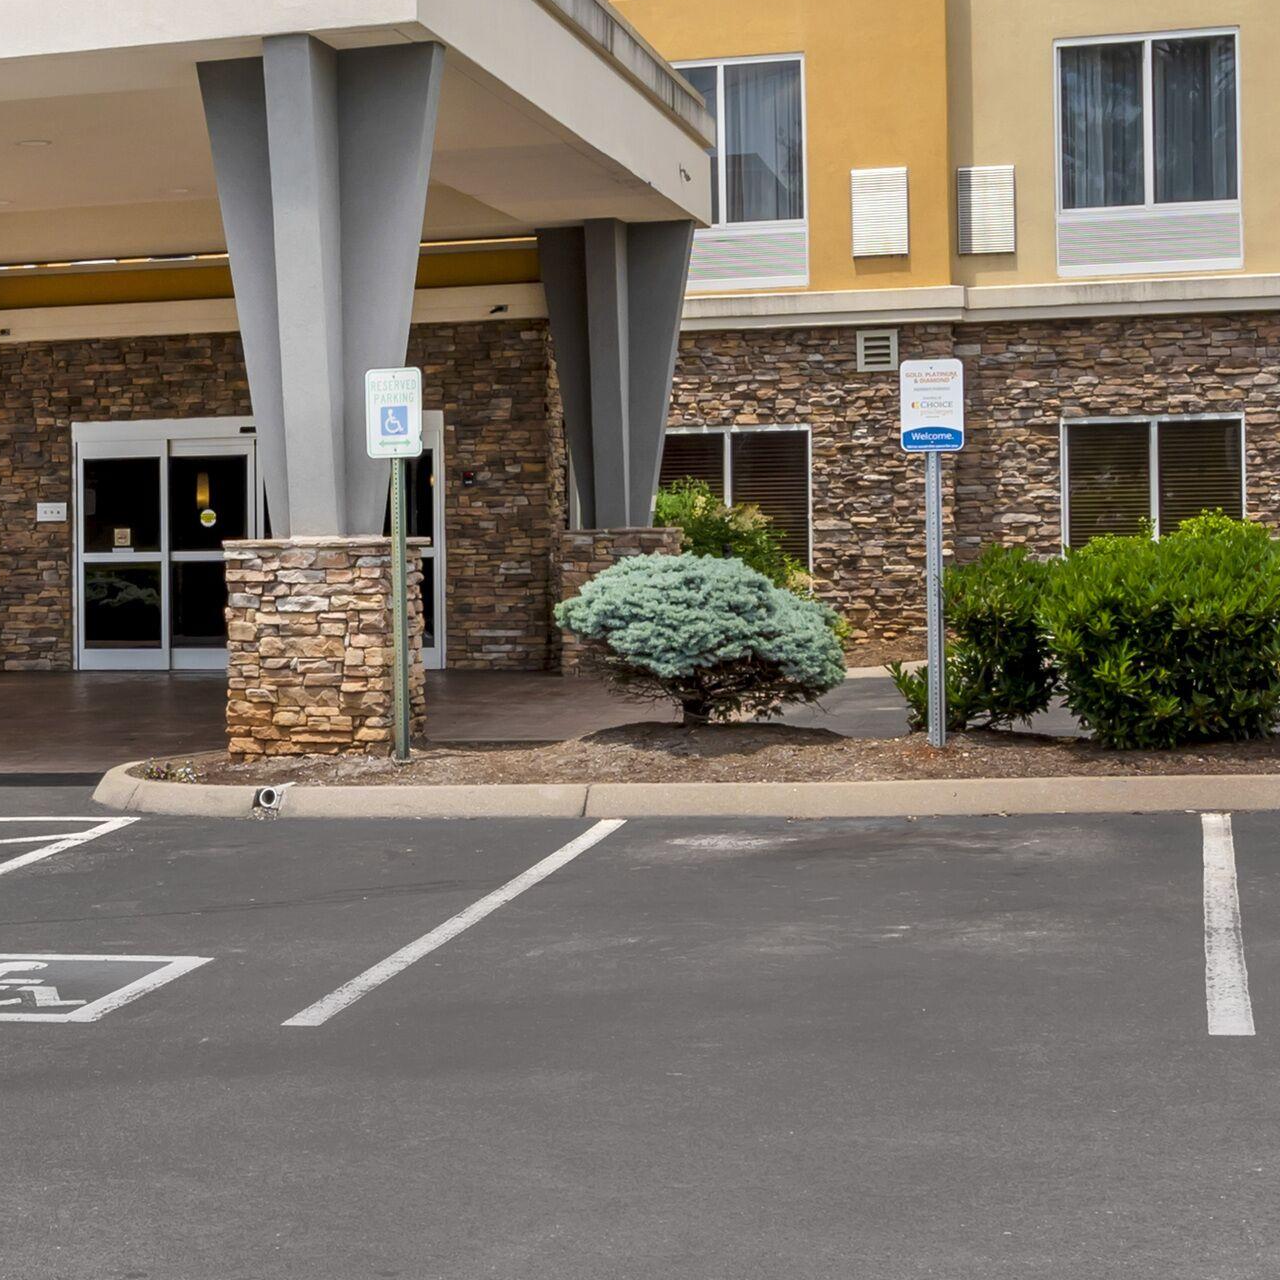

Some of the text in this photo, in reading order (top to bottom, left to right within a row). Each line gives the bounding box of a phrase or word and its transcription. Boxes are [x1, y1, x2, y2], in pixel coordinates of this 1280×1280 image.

[370, 379, 417, 392] RESERVED
[373, 392, 414, 404] PARKING
[911, 432, 955, 441] Welcome.
